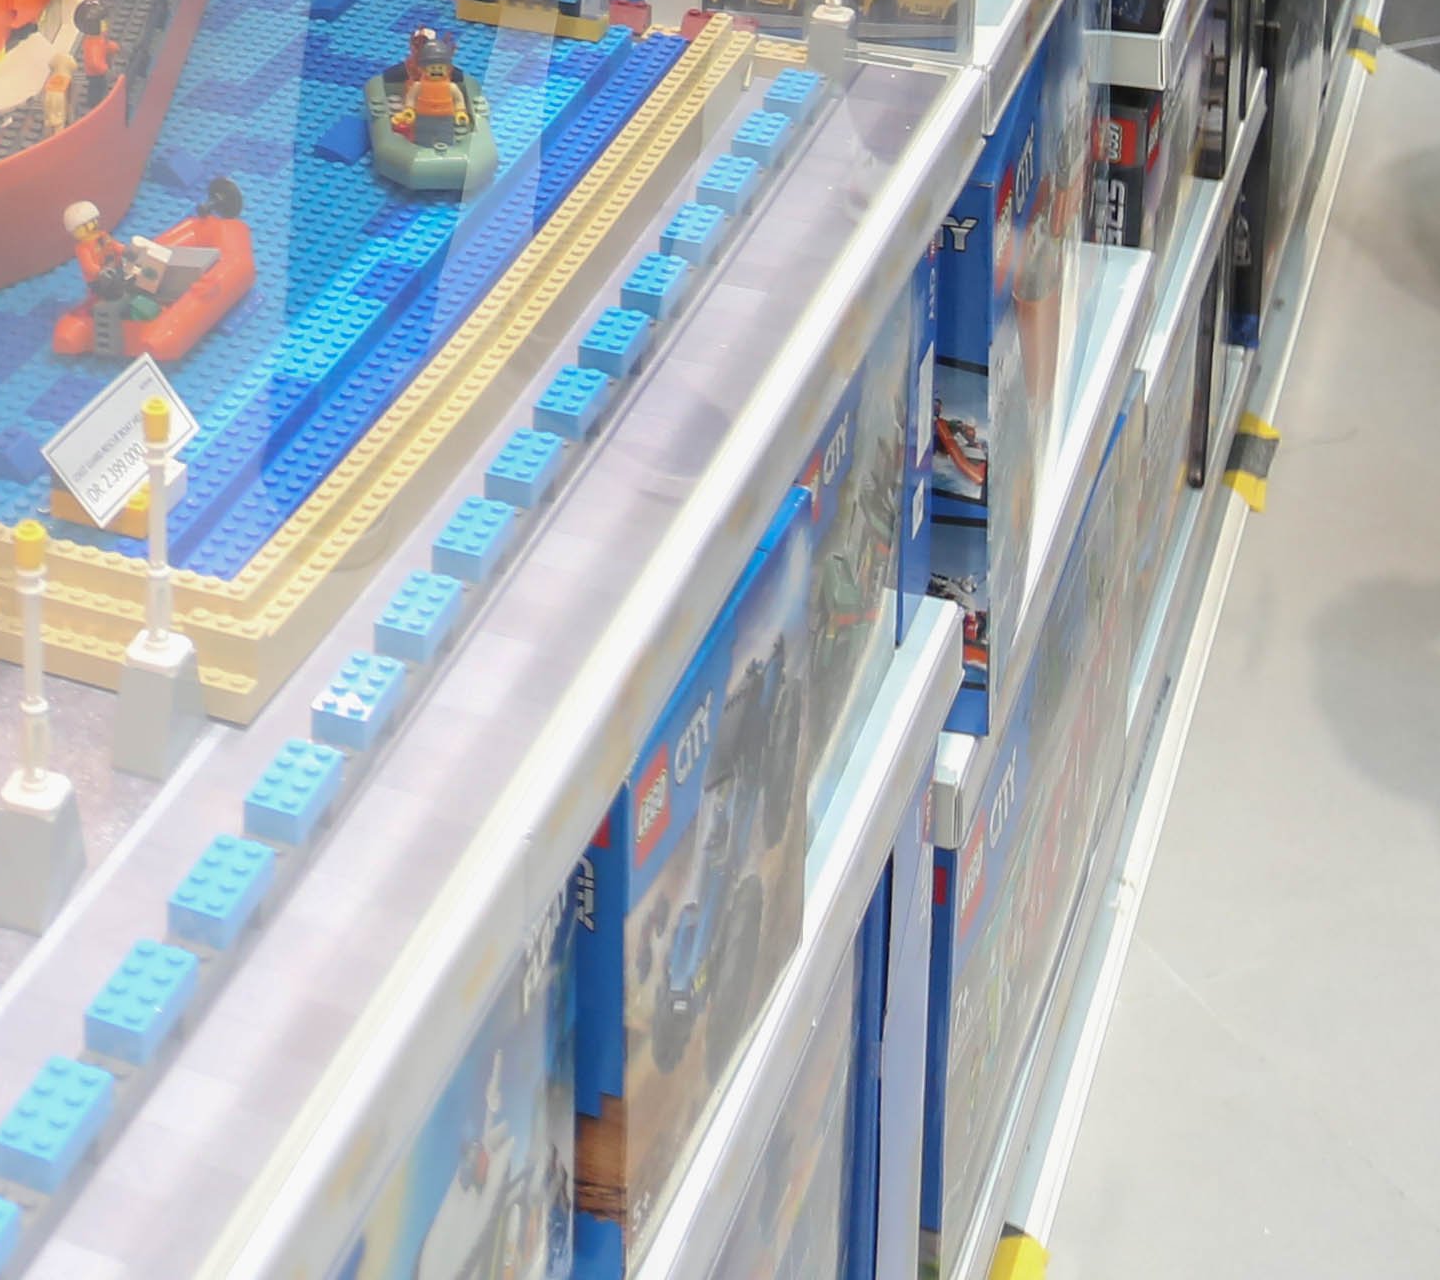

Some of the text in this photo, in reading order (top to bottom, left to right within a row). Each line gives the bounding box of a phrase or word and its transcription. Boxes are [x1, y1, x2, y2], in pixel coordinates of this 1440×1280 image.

[940, 215, 978, 252] TY
[822, 416, 851, 487] CITY
[638, 691, 714, 843] LEGO CITY
[990, 748, 1017, 849] CITY
[577, 852, 596, 934] CITY
